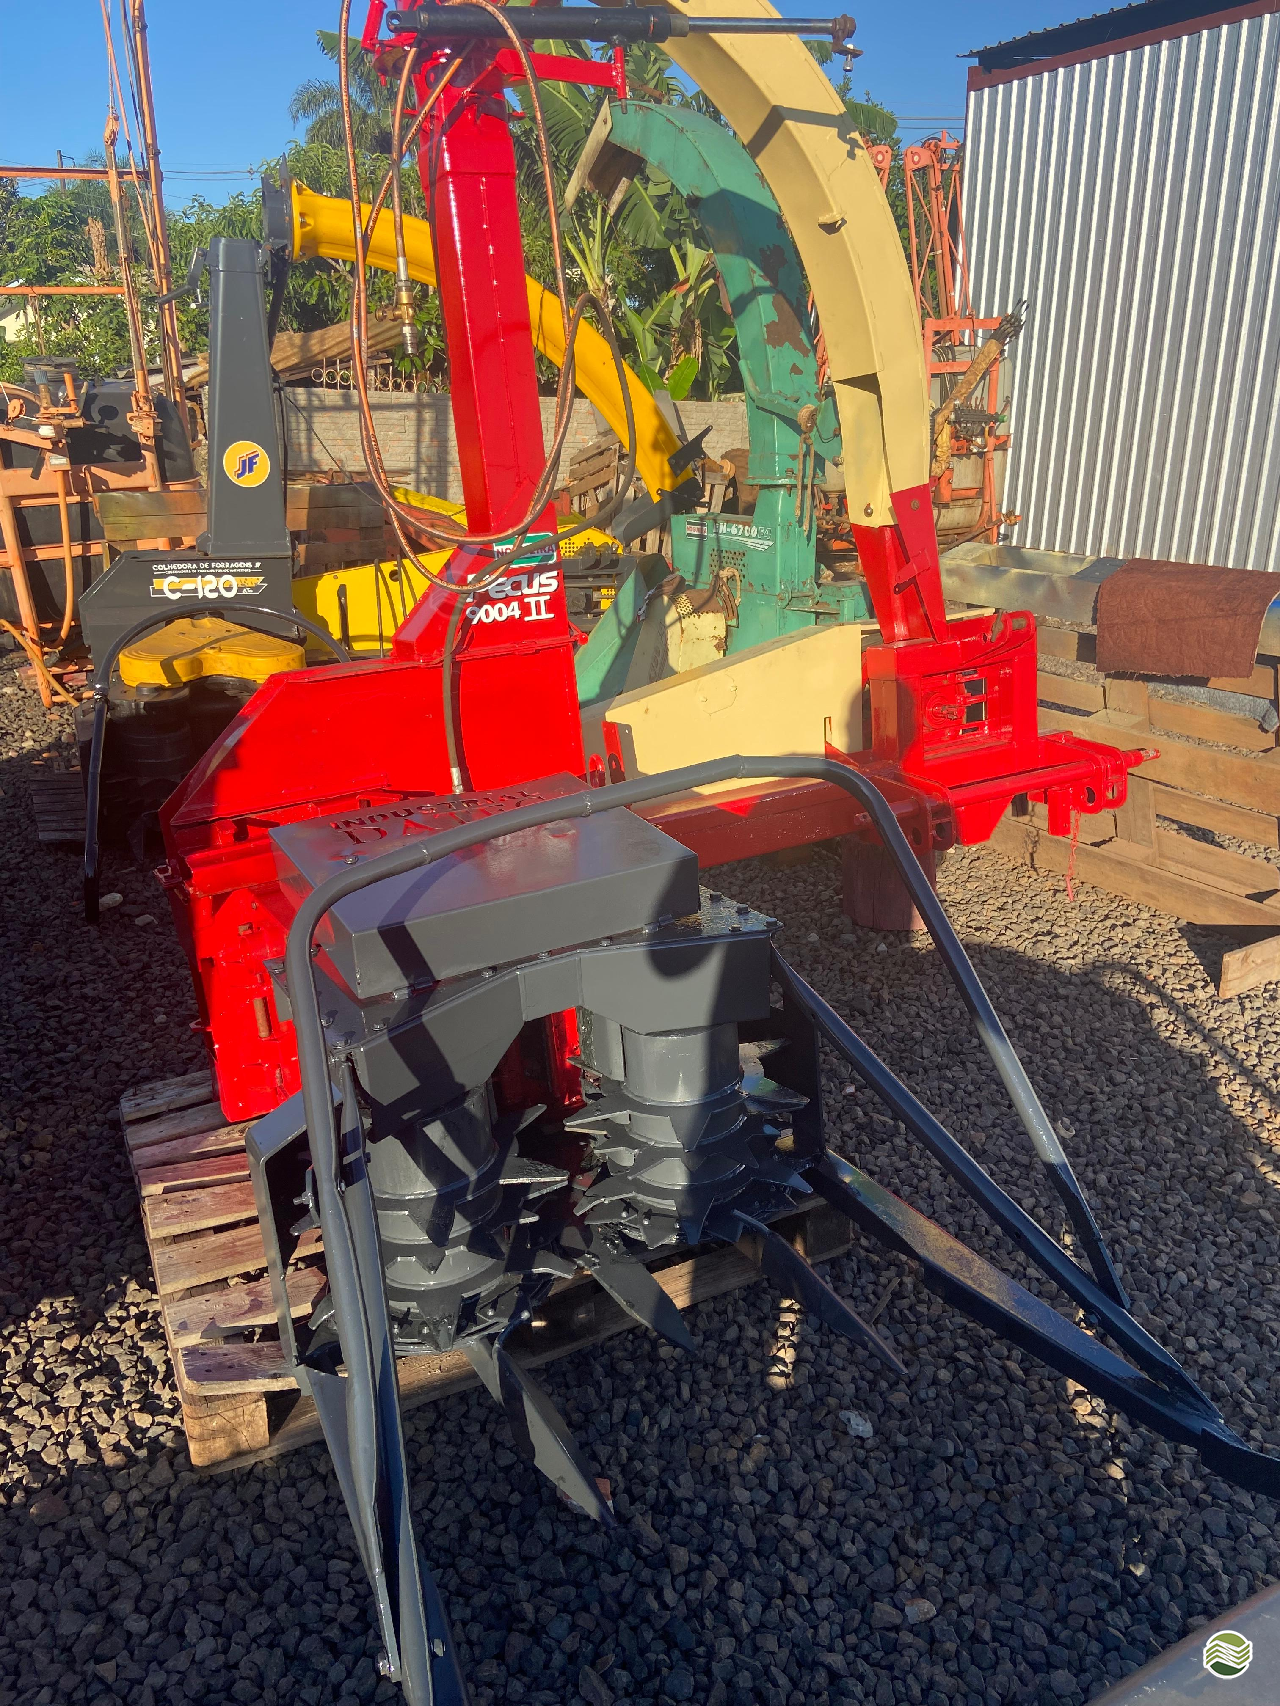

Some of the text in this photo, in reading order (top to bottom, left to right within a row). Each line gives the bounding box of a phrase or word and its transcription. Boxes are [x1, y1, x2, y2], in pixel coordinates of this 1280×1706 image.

[234, 450, 260, 479] JF
[152, 562, 198, 571] COLHEDORA
[211, 561, 253, 569] FORRAGENS
[163, 574, 238, 600] C-120
[465, 600, 522, 625] 9004
